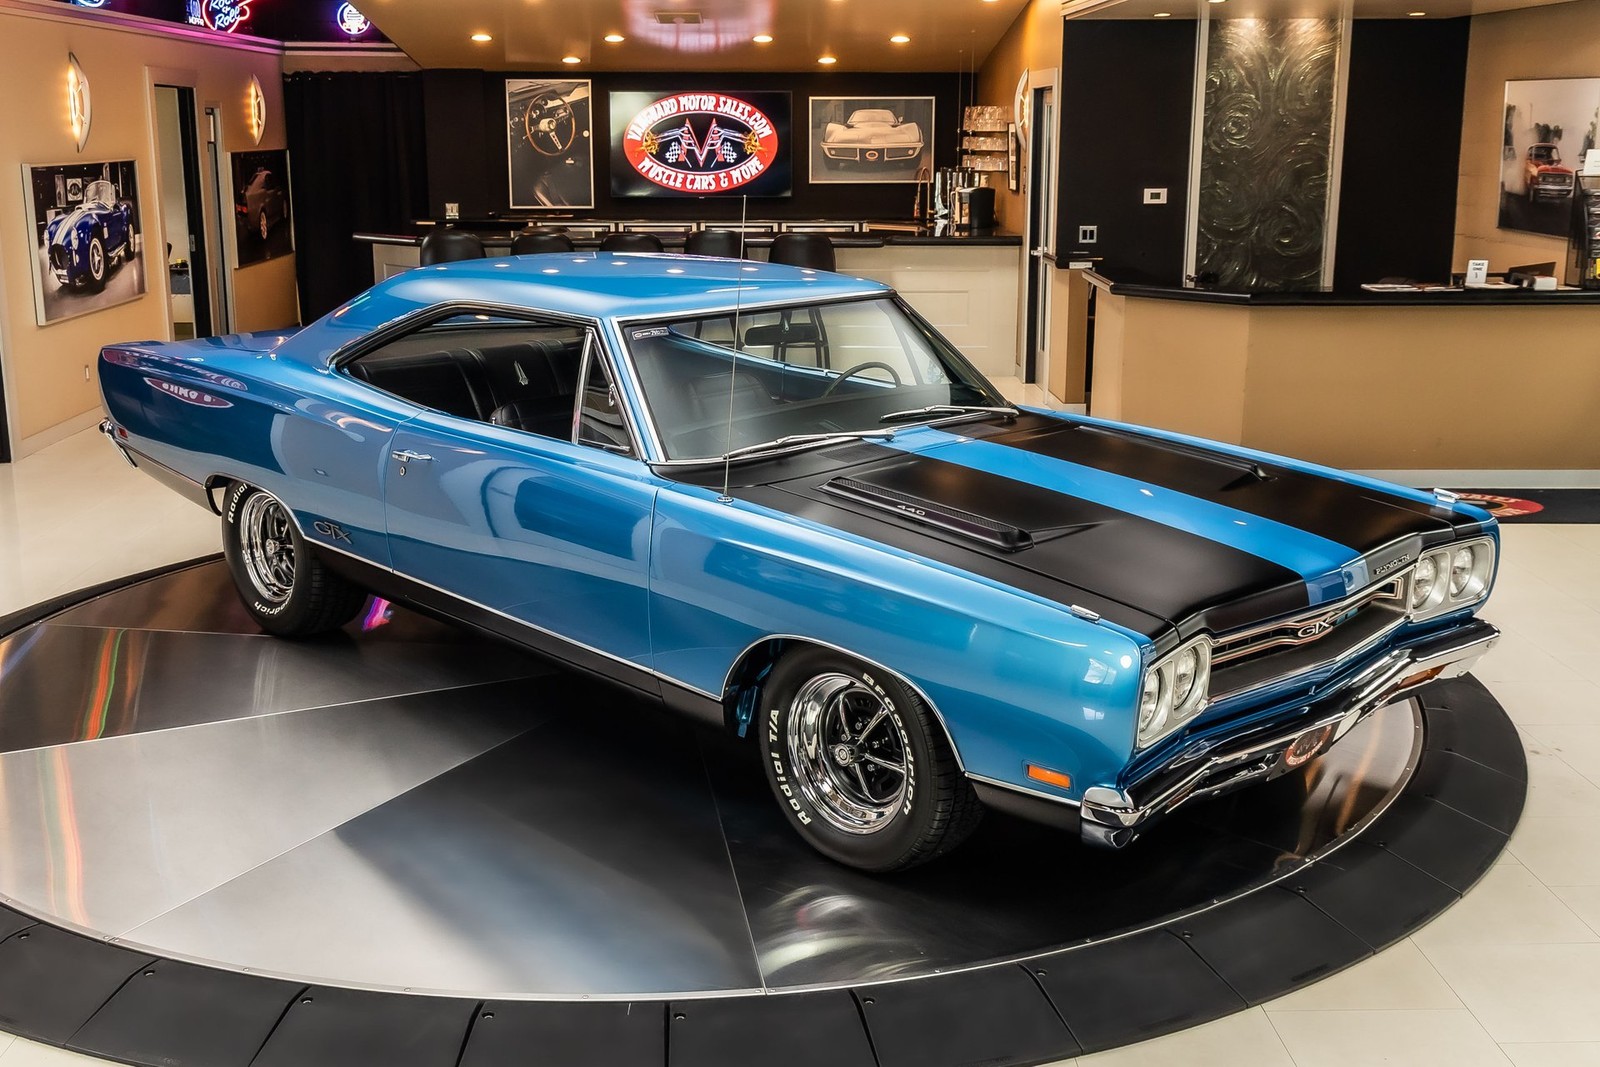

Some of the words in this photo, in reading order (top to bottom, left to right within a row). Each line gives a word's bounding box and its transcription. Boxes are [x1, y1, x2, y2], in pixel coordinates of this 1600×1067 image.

[215, 6, 241, 30] Roll
[627, 98, 678, 142] VANGUARD
[680, 95, 715, 112] MOTOR
[717, 97, 772, 139] SALES.COM
[637, 156, 684, 188] MUSCLE
[686, 175, 716, 190] CARS
[719, 172, 729, 187] &
[730, 157, 764, 186] MORE
[227, 483, 248, 524] Radial
[897, 505, 926, 516] 440
[313, 521, 352, 545] GTX
[1374, 554, 1410, 575] PLYMOUTH
[1297, 616, 1331, 638] GTX
[768, 709, 780, 743] T/A
[862, 672, 917, 817] BFGoodrich
[770, 751, 812, 826] Radial
